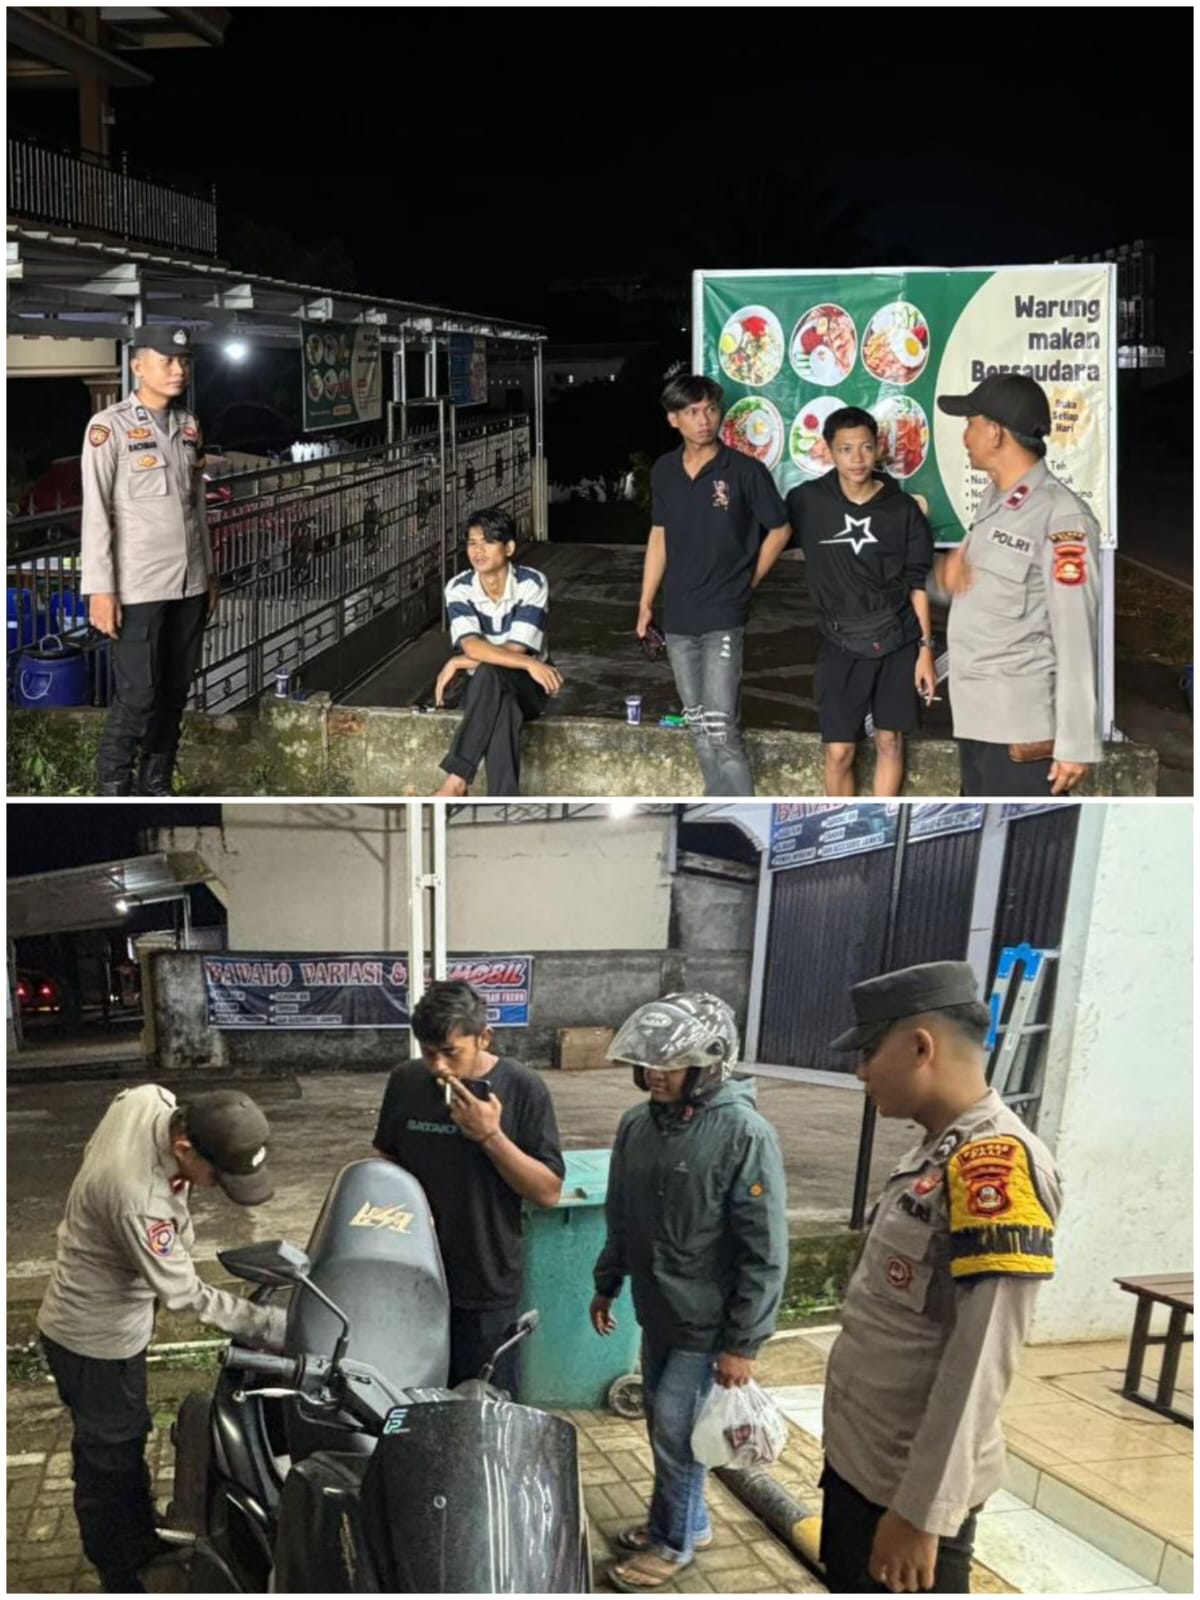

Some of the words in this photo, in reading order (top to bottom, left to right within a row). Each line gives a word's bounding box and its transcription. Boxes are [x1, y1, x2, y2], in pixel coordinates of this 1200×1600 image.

[1014, 295, 1101, 323] Warung
[1028, 327, 1100, 350] makan
[991, 529, 1030, 553] POLRI
[300, 961, 383, 987] VARIASI
